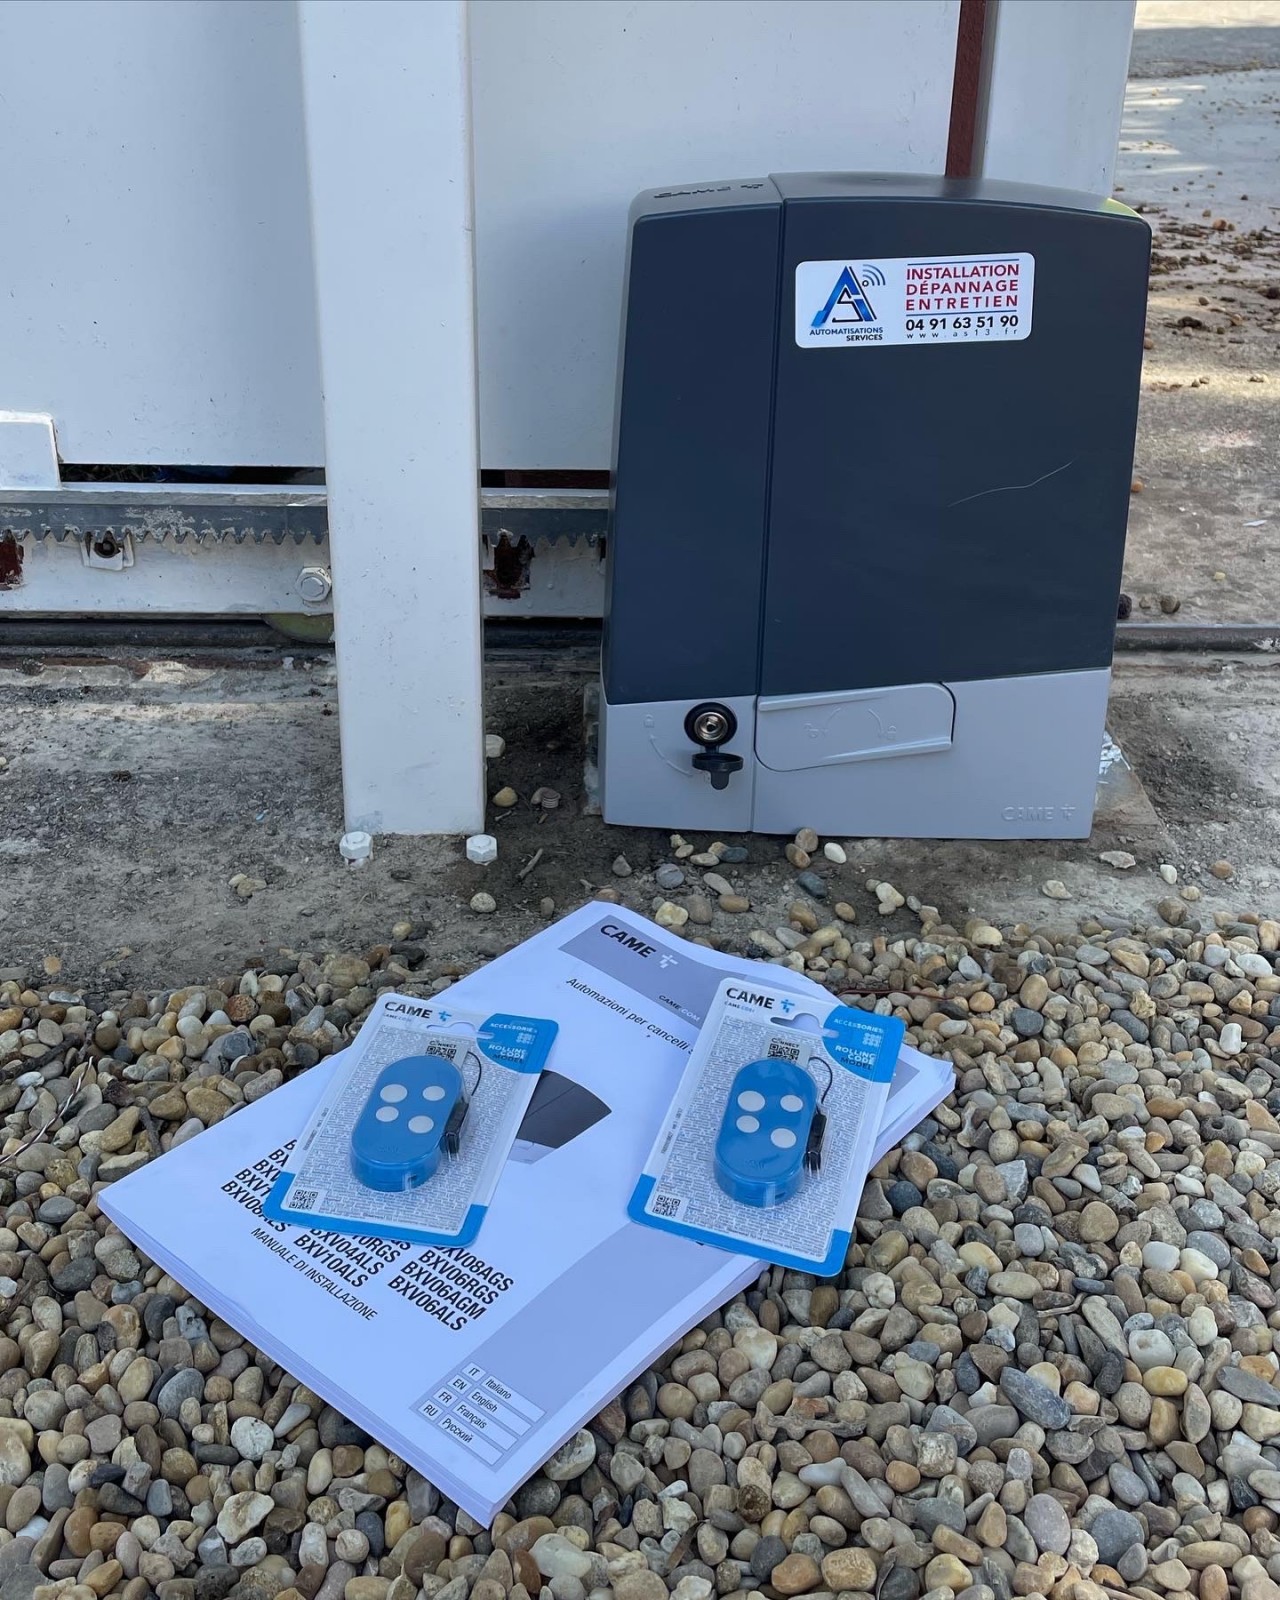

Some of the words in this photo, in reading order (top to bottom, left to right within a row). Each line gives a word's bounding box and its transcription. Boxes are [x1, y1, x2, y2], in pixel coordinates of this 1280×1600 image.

[906, 264, 1019, 280] INSTALLATION
[906, 280, 1018, 296] DÉPANNAGE
[906, 295, 1018, 311] ENTRETIEN
[809, 326, 884, 336] AUTOMATISATIONS
[906, 319, 924, 331] 04
[929, 318, 946, 330] 91
[953, 317, 971, 329] 63
[976, 316, 993, 328] 51
[1000, 315, 1019, 327] 90
[846, 334, 883, 342] SERVICES
[1001, 806, 1055, 822] CAME
[600, 924, 657, 958] CAME
[726, 987, 775, 1010] CAME
[384, 1001, 433, 1019] CAME
[566, 978, 630, 1016] Automazioni
[625, 1011, 648, 1026] per
[647, 1023, 691, 1052] cancelli
[835, 1045, 876, 1059] ROLLING
[847, 1053, 875, 1067] CODE
[840, 1056, 873, 1070] MODEL
[293, 1233, 369, 1288] BXV10ALS
[250, 1227, 298, 1264] MANUALE
[293, 1259, 309, 1273] DI
[304, 1267, 378, 1321] INSTALLAZIONE
[418, 1249, 499, 1305] BXV06RGS
[400, 1260, 487, 1320] BXV06AGM
[387, 1275, 468, 1331] BXV06ALS
[468, 1367, 480, 1377] IT
[485, 1379, 512, 1400] Italiano
[452, 1378, 467, 1391] EN
[471, 1391, 498, 1413] English
[423, 1404, 438, 1417] RU
[438, 1391, 453, 1404] FR
[457, 1404, 487, 1429] Français
[442, 1417, 474, 1444] Русский
